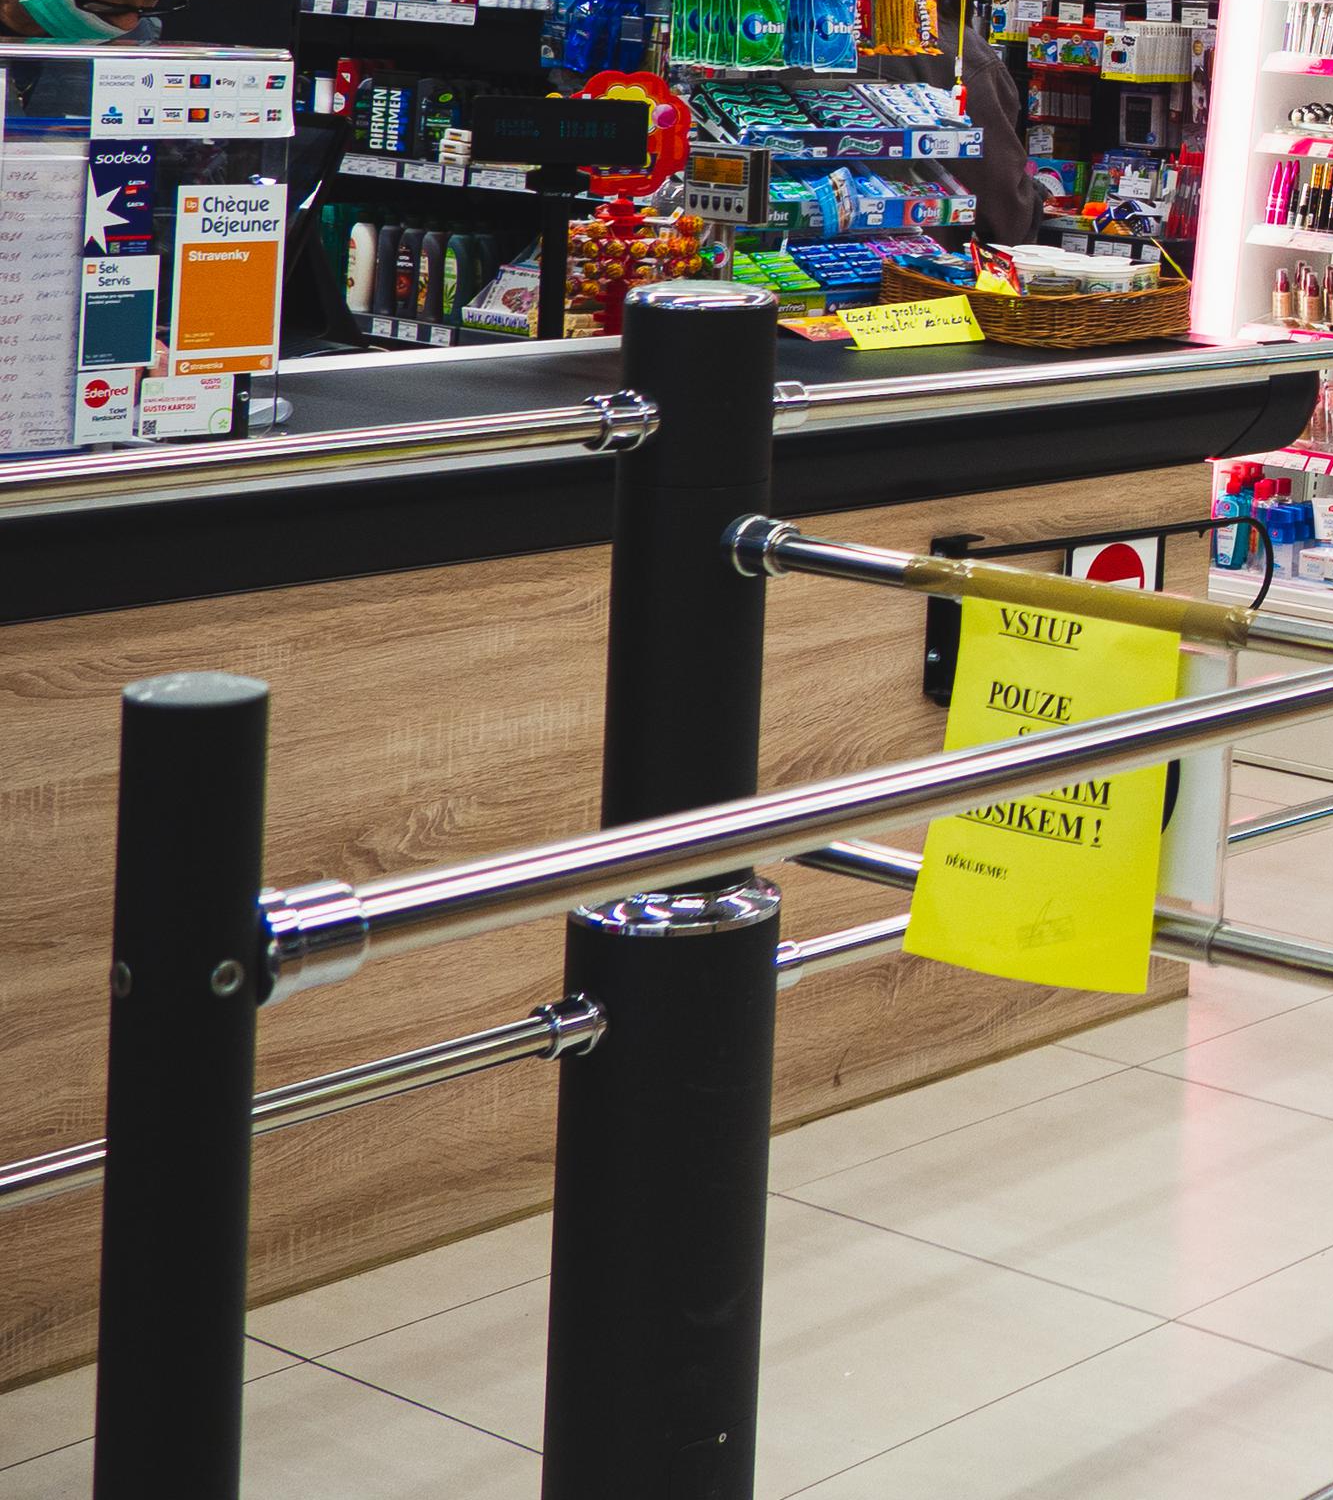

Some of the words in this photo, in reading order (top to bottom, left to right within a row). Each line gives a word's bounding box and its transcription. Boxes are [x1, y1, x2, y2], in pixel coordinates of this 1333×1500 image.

[370, 88, 386, 150] AIRMEN
[386, 90, 401, 151] AIRMEN
[95, 145, 151, 165] sodexo
[202, 195, 270, 216] Chèque
[201, 216, 280, 237] Déjeuner
[188, 250, 250, 262] Stravenky
[98, 262, 119, 274] Šek
[98, 275, 131, 287] Servis
[84, 385, 129, 399] Edenred
[143, 405, 167, 413] GUSTO
[1000, 607, 1082, 645] VSTUP
[988, 681, 1072, 722] POUZE
